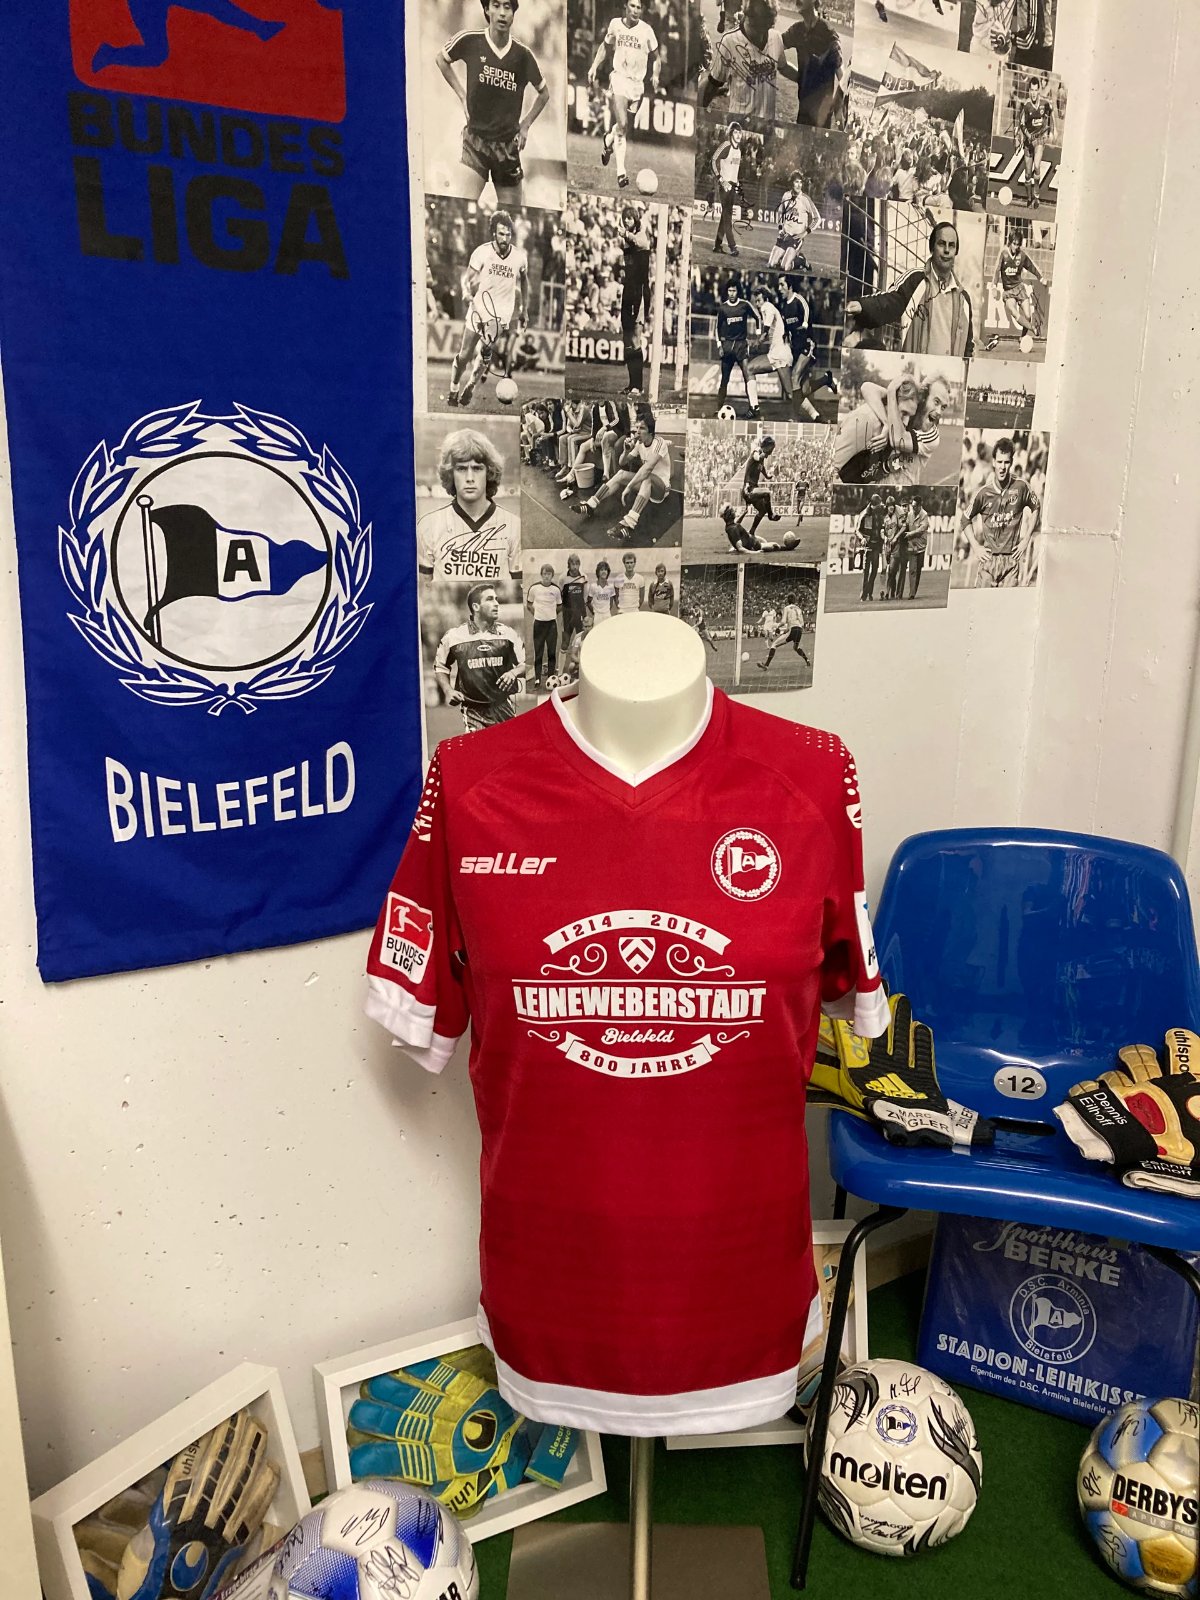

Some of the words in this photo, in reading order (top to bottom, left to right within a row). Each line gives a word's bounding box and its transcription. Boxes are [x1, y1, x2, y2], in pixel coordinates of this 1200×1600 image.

[478, 73, 518, 92] STICKER
[483, 65, 515, 82] SEIDEN
[67, 91, 345, 178] BUNDES
[72, 155, 351, 280] LIGA
[443, 562, 501, 578] STICKER
[450, 550, 498, 566] SEIDEN
[105, 741, 356, 843] BIELEFELD
[459, 852, 557, 875] saller
[560, 914, 613, 943] 1214
[650, 913, 707, 941] 2014
[386, 936, 425, 966] BUNDES
[392, 952, 413, 974] LIGA
[512, 985, 767, 1020] LEINEWEBERSTADT
[601, 1027, 675, 1046] Bielefeld
[579, 1049, 619, 1073] 800
[630, 1053, 697, 1075] JAHRE
[1007, 1075, 1036, 1094] 12
[898, 1109, 932, 1120] MARC
[1080, 1096, 1115, 1127] Eilhoff
[1093, 1091, 1128, 1126] Dennis
[1004, 1239, 1121, 1288] BERKE
[1057, 1279, 1090, 1316] Arminia
[1024, 1339, 1073, 1361] Bielefeld
[970, 1364, 1003, 1382] Eigentum
[1003, 1375, 1017, 1387] des
[1041, 1387, 1071, 1404] Arminia
[1072, 1397, 1106, 1415] Bielefeld
[829, 1451, 948, 1501] molten
[1132, 1510, 1168, 1529] APUS
